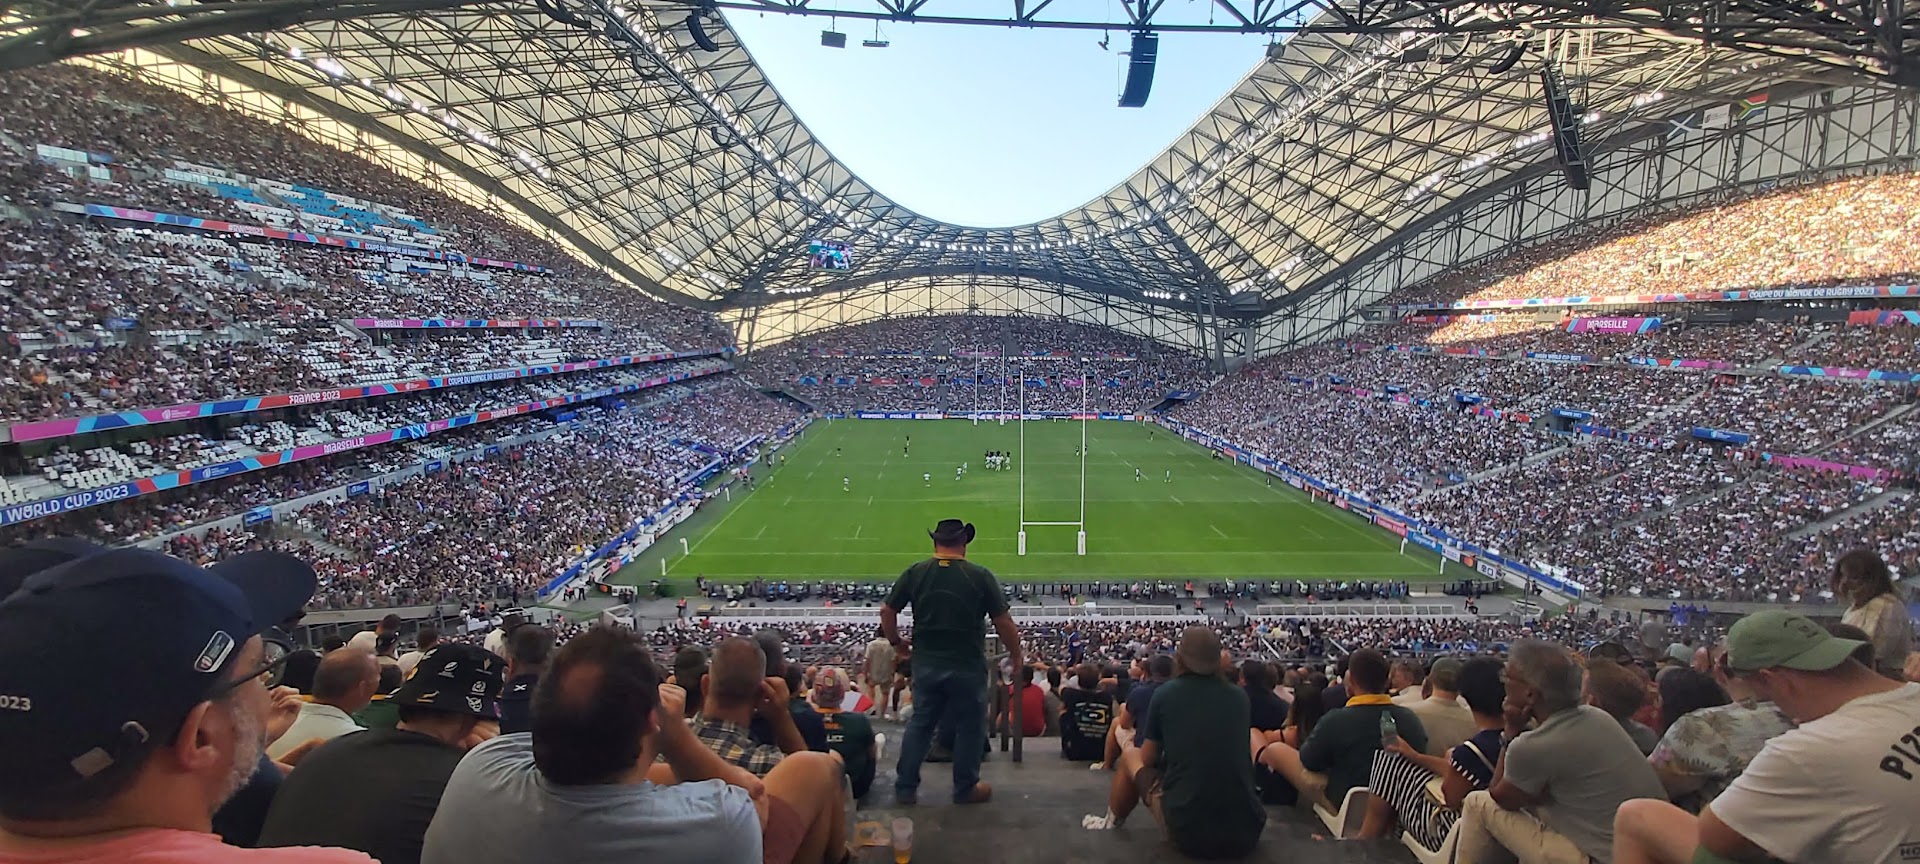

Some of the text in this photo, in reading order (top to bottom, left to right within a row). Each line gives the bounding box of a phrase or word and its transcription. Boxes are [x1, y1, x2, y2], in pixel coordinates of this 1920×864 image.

[1749, 290, 1773, 298] COUPE
[1773, 290, 1784, 298] DU
[1785, 288, 1813, 297] MONDE
[1813, 288, 1825, 297] DE
[1853, 287, 1875, 295] 2023
[1587, 320, 1628, 329] MARSEILLE
[448, 376, 464, 386] COUPE
[464, 375, 471, 384] DU
[288, 390, 341, 405] FRANCE 2023
[323, 437, 365, 454] MARSEILLE
[7, 485, 129, 522] WORLD CUP 2023
